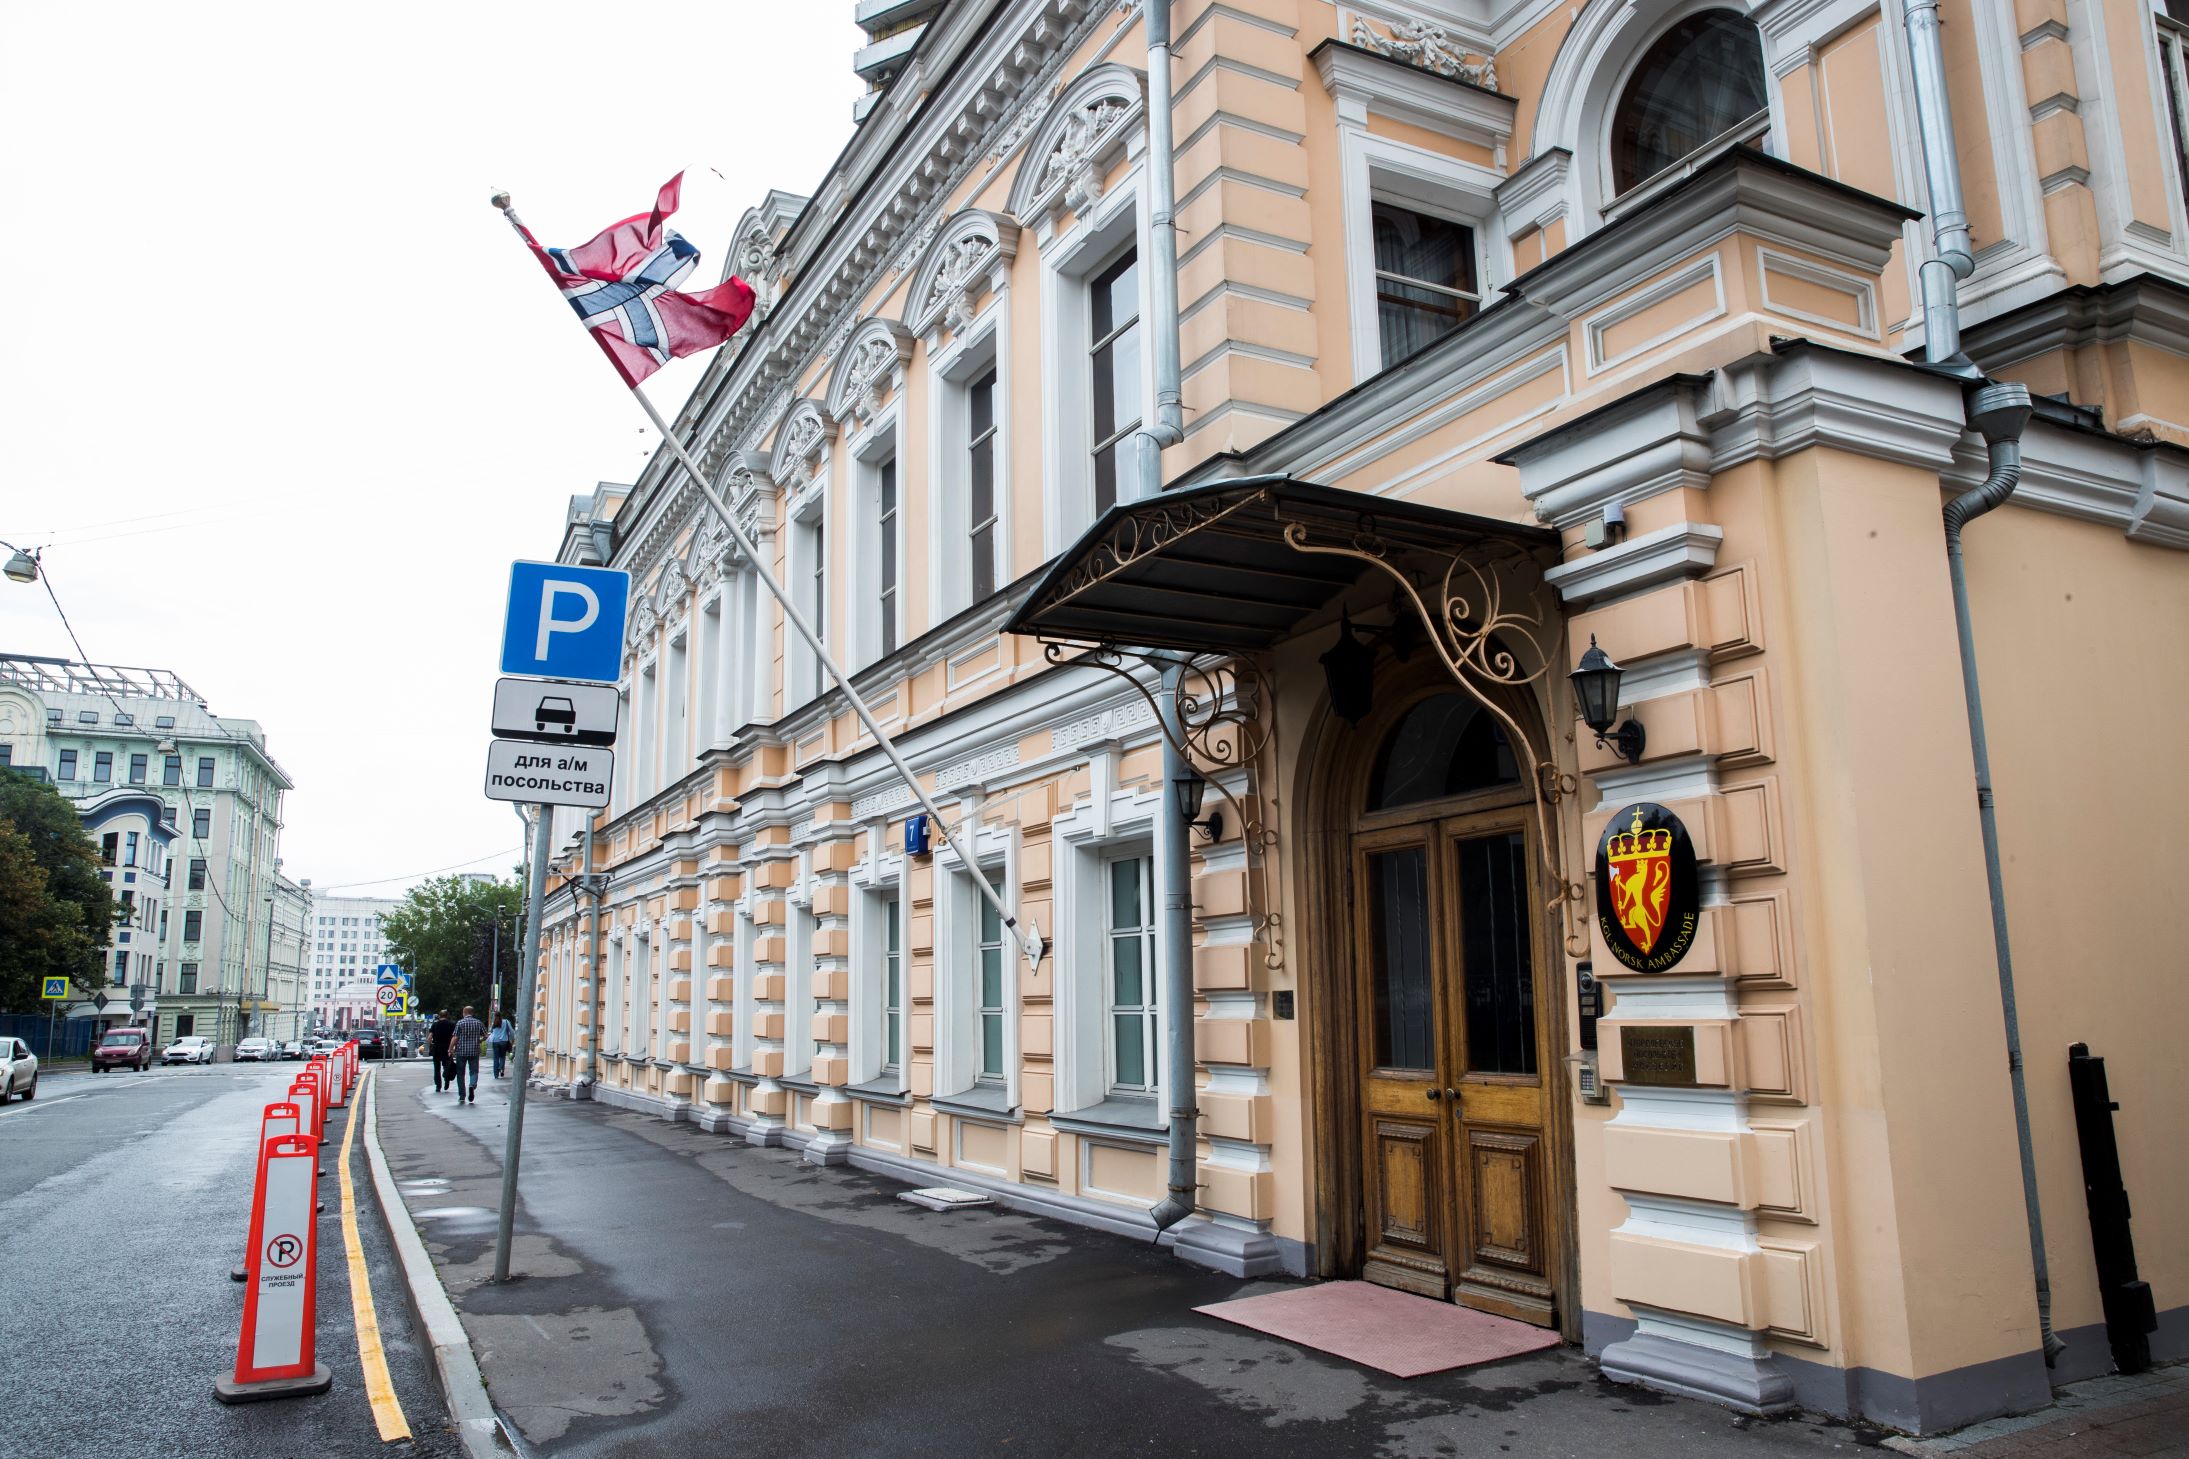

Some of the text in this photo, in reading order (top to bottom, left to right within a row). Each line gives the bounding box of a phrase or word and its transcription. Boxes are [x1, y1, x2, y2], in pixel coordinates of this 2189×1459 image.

[534, 578, 600, 662] P
[514, 755, 588, 772] для а/м
[491, 774, 605, 795] посольства
[909, 824, 915, 842] 7
[1611, 942, 1645, 969] NORSK
[1647, 912, 1695, 969] AMBASSADE
[380, 991, 394, 1000] 20
[278, 1241, 295, 1262] P
[261, 1273, 304, 1282] СЛУЖЕБНЫЙ
